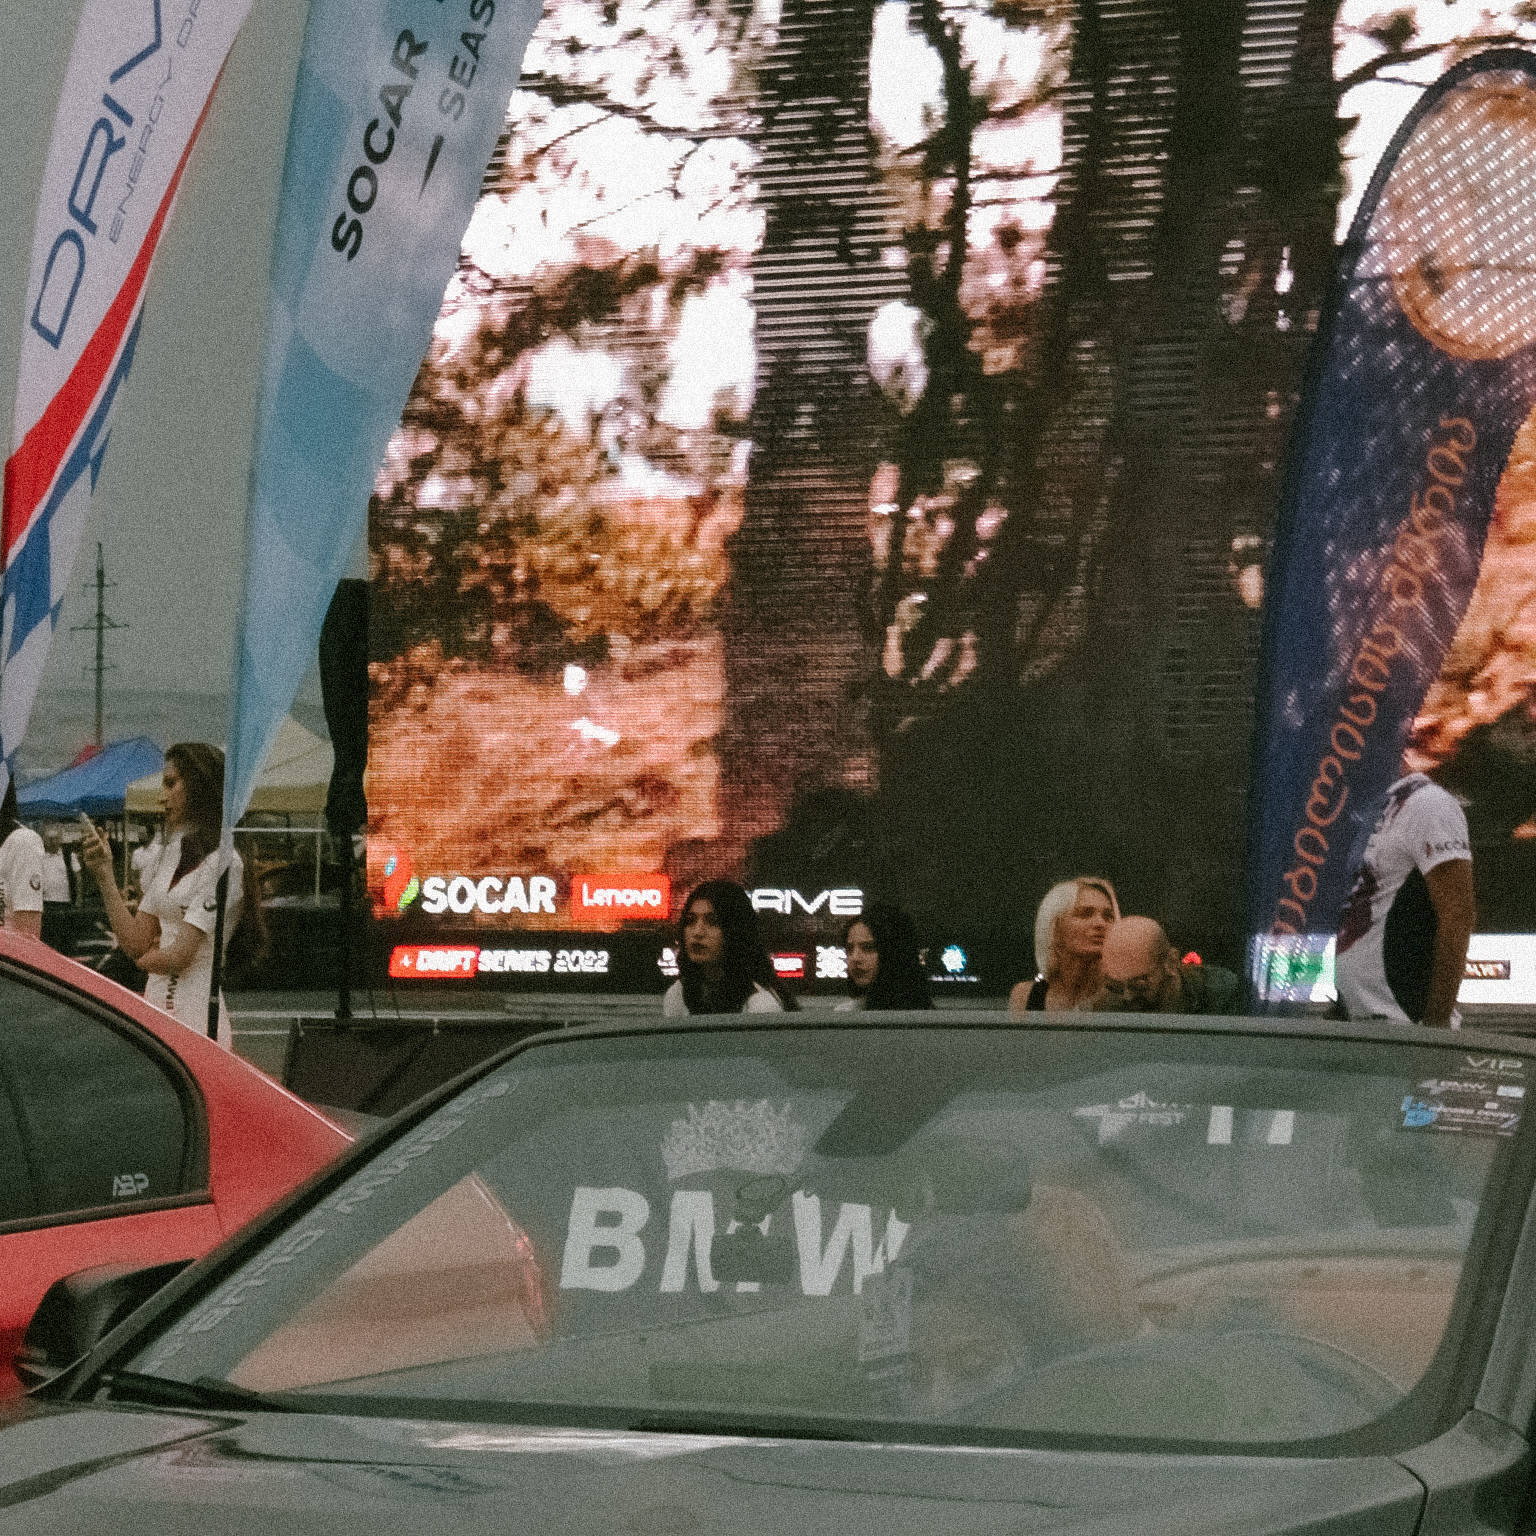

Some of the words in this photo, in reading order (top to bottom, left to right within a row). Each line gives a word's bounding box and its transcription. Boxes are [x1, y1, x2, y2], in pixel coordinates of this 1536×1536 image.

[438, 0, 496, 121] SEAS
[109, 57, 173, 245] ENERGY
[331, 28, 429, 262] SOCAR
[422, 876, 557, 914] SOCAR
[582, 882, 662, 908] Lenovo
[746, 887, 864, 916] RIVE
[415, 950, 477, 972] DRIFT
[477, 950, 552, 972] SERIES
[553, 950, 610, 973] 2022
[1467, 1055, 1524, 1070] VIP
